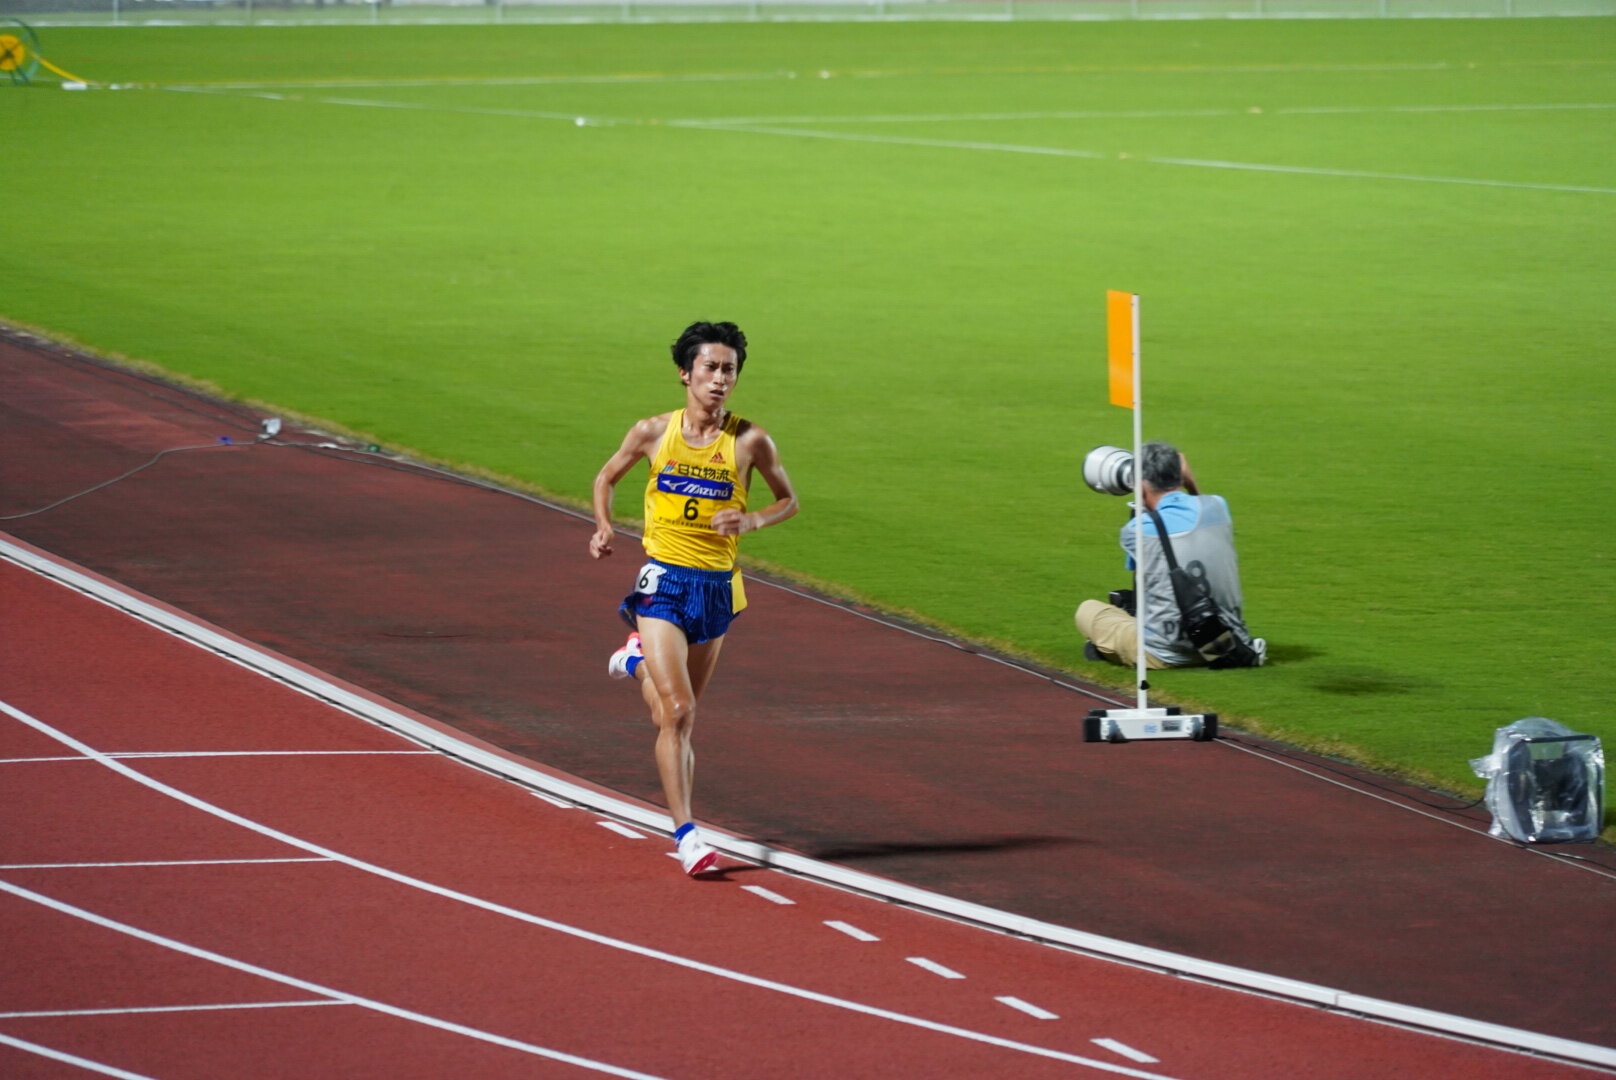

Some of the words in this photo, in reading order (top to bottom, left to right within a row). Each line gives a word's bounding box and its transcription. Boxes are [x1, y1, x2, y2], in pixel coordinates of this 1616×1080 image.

[678, 463, 730, 481] 日立物流
[683, 498, 699, 521] 6
[639, 568, 655, 589] 6
